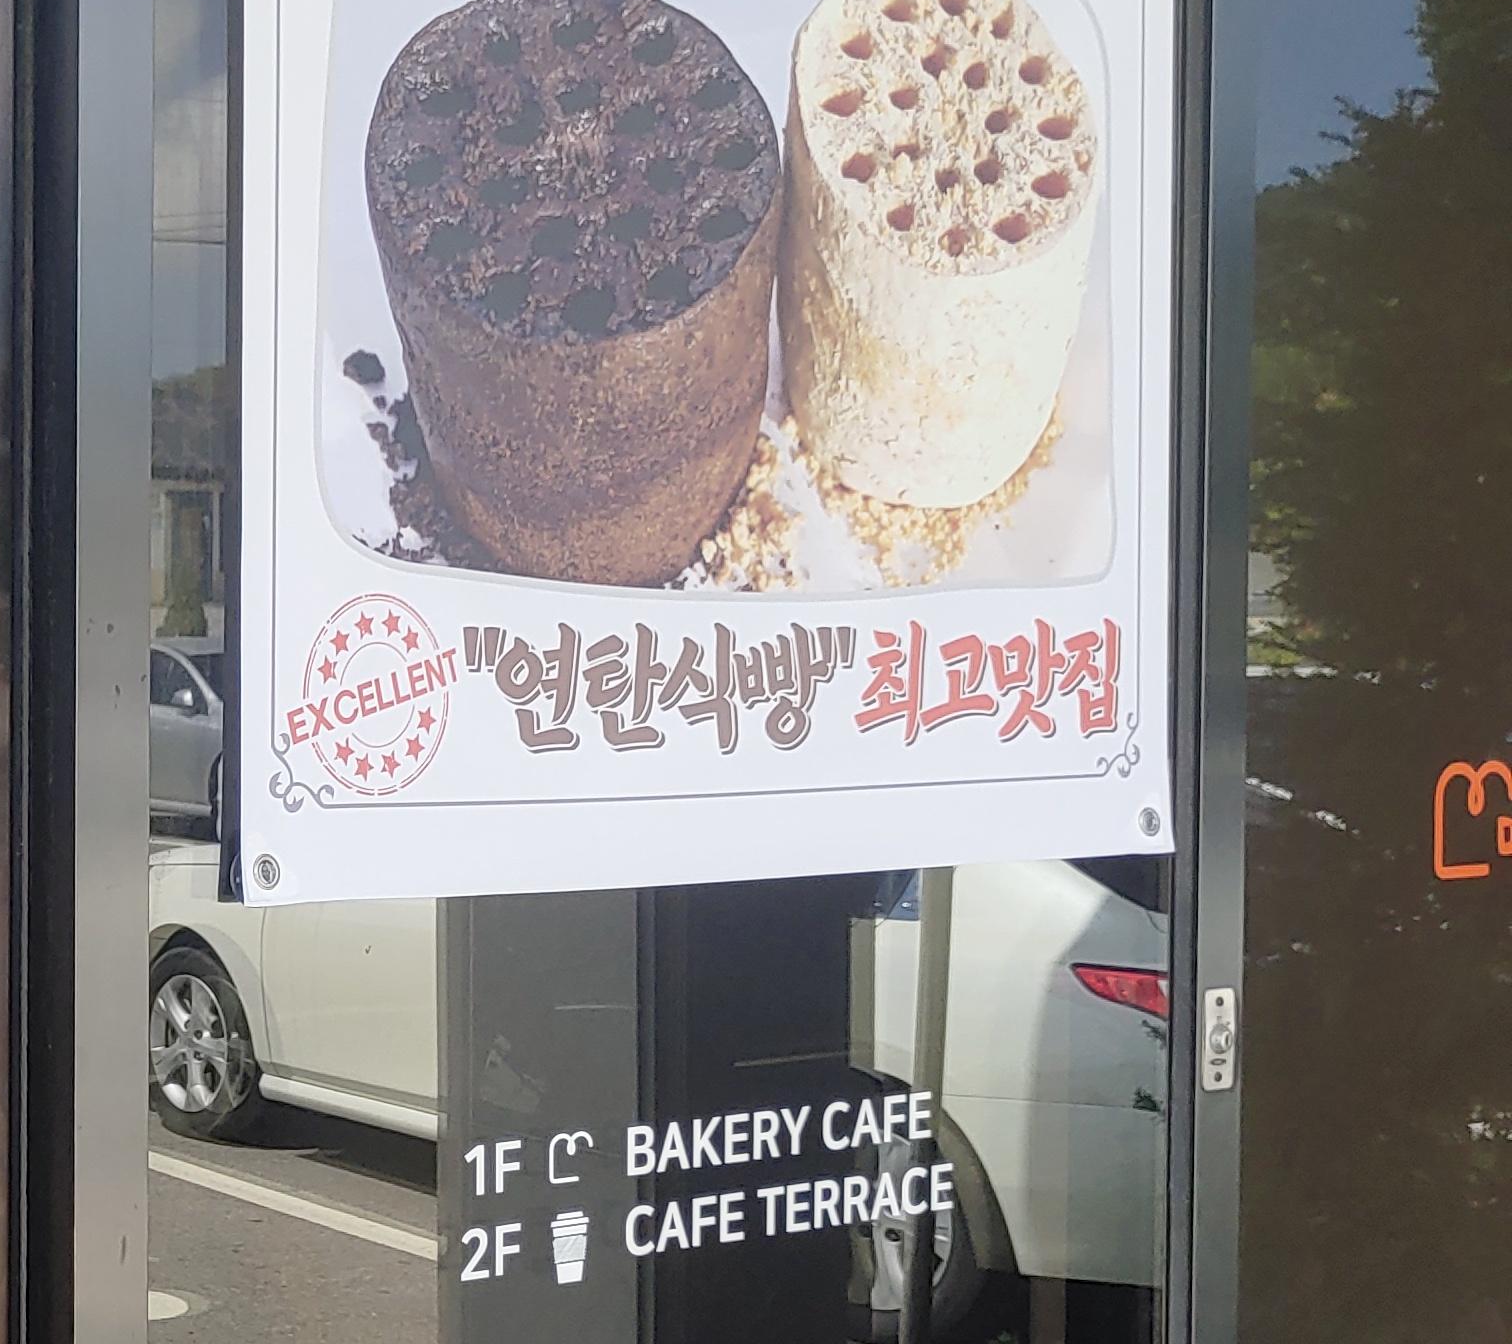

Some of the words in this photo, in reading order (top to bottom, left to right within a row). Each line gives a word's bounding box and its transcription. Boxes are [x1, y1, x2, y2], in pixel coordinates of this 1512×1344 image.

[286, 646, 458, 745] EXCELLENT
[462, 621, 856, 755] "연탄식빵"
[463, 1139, 522, 1197] 1F
[626, 1105, 811, 1177] BAKERY
[821, 1090, 932, 1152] CAFE
[460, 1222, 522, 1283] 2F
[624, 1191, 746, 1257] CAFE
[756, 1162, 955, 1237] TERRACE
